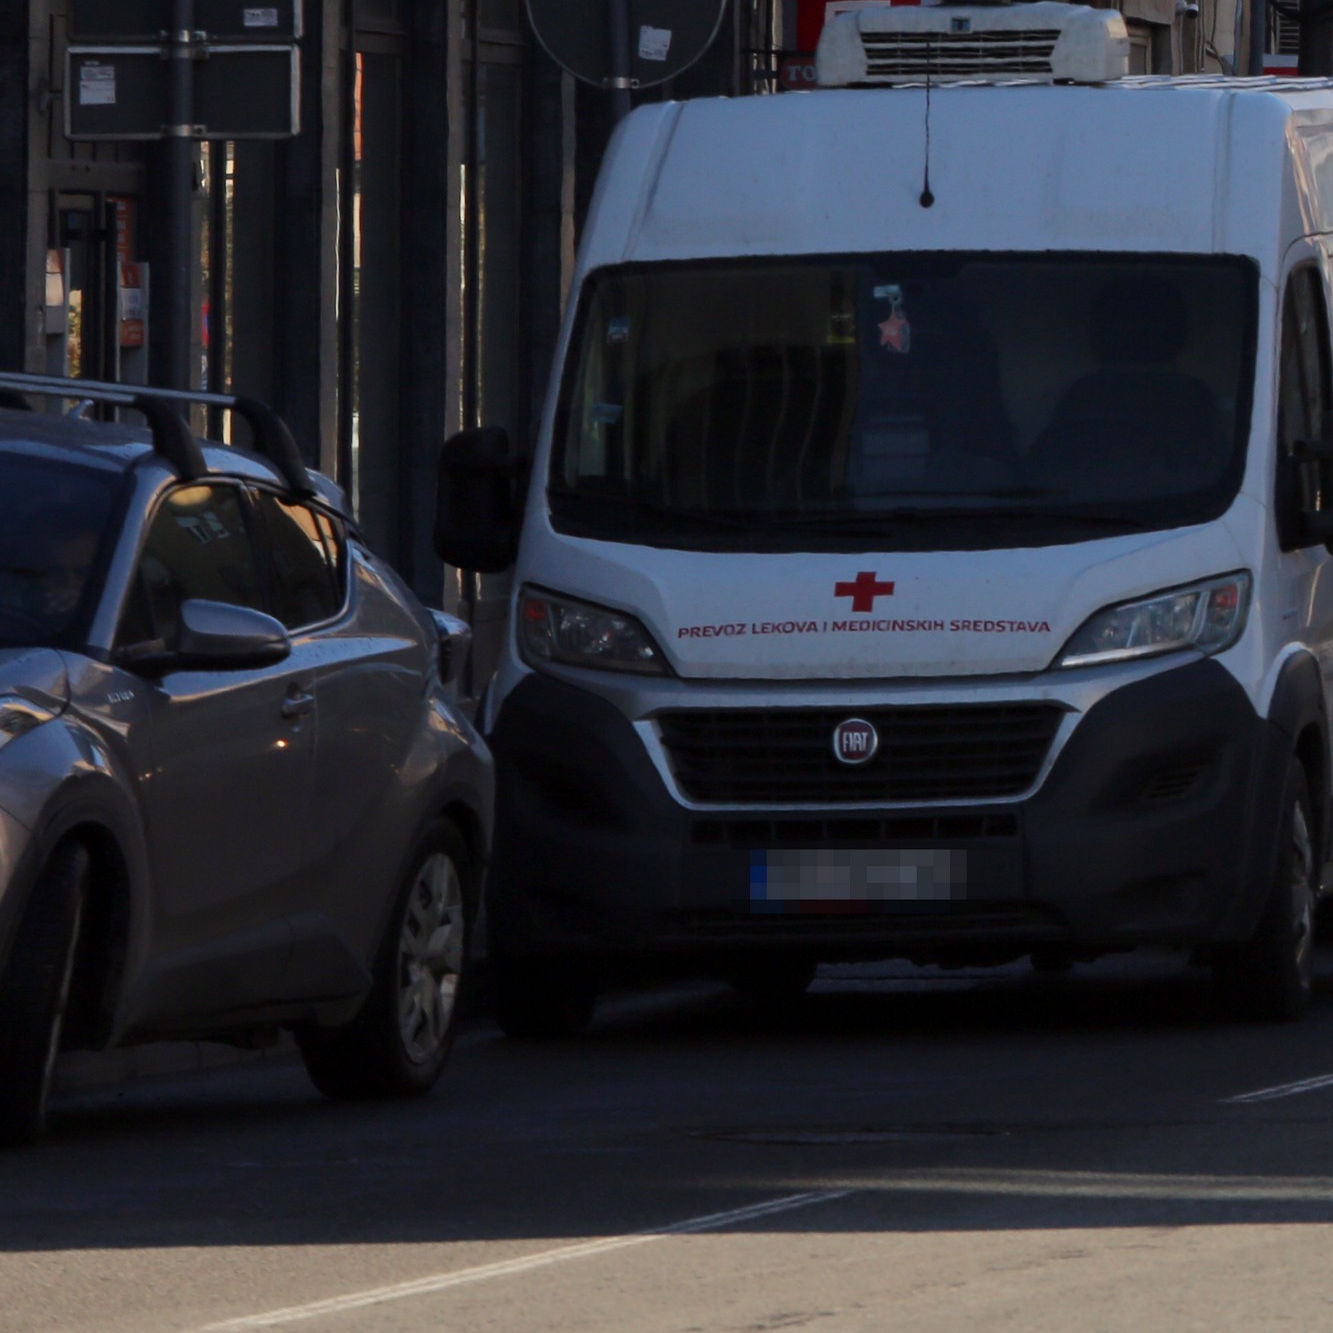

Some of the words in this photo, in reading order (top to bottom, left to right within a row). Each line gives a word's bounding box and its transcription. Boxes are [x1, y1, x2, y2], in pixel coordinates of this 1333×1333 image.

[678, 623, 746, 638] PREVOZ
[752, 621, 818, 634] LEKOVA
[823, 621, 827, 633] I
[832, 619, 944, 633] MEDICINSKIH
[950, 619, 1050, 633] SREDSTAVA
[842, 731, 869, 752] FIAT
